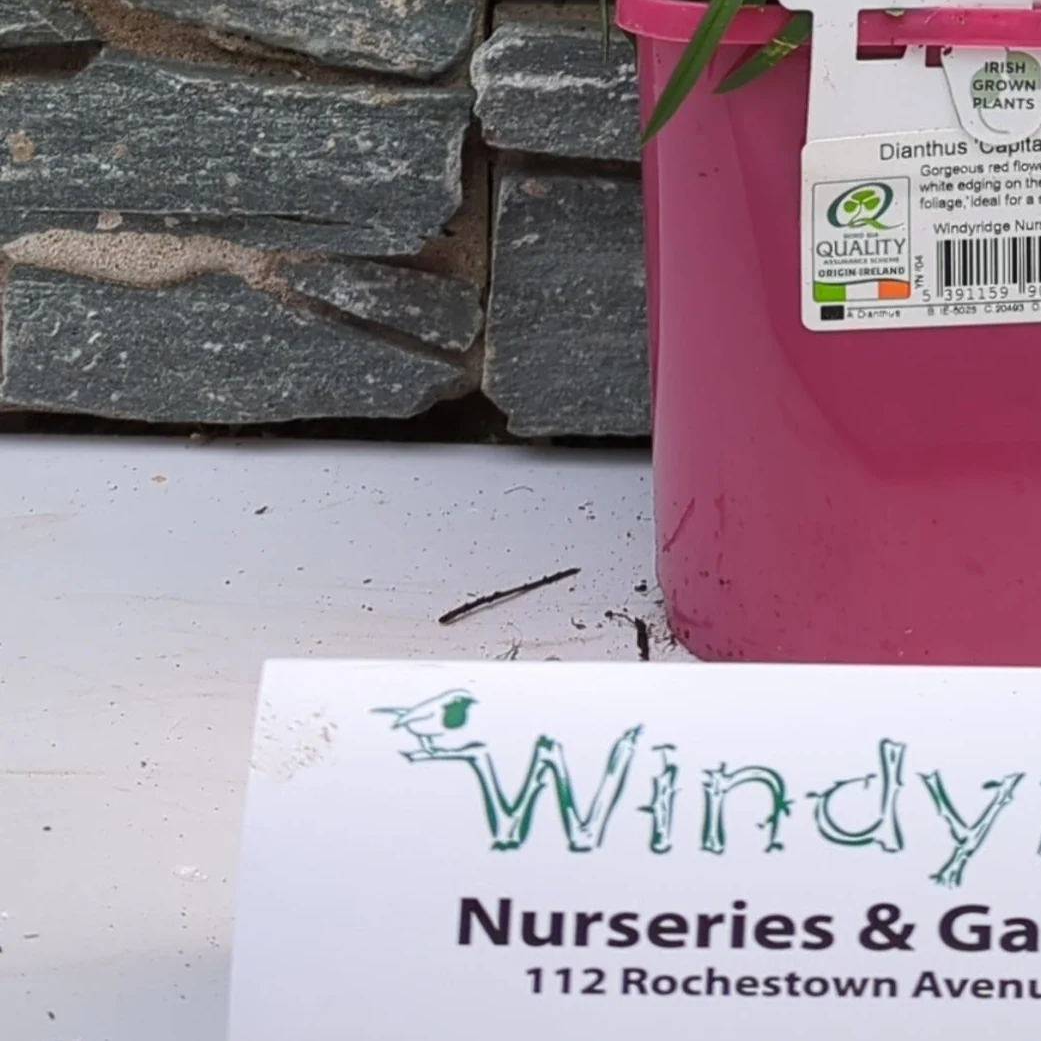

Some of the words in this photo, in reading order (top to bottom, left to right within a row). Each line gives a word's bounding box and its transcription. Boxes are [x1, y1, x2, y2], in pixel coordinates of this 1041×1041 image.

[984, 61, 1026, 74] IRISH
[972, 79, 1036, 91] GROWN
[973, 97, 1035, 110] PLANTS
[880, 140, 968, 160] Dianthus
[920, 163, 984, 178] Gorgeous
[989, 162, 1009, 173] red
[919, 180, 954, 193] white
[957, 178, 1001, 194] edging
[1005, 180, 1021, 189] on
[970, 195, 1001, 207] ideal
[1005, 194, 1022, 206] for
[1026, 196, 1034, 205] a
[933, 220, 1011, 236] Windyridge
[816, 238, 906, 258] QUALITY
[922, 289, 931, 302] 5
[944, 286, 1009, 301] 391159
[457, 896, 835, 950] Nurseries
[858, 902, 917, 952] &
[526, 967, 606, 995] 112
[621, 966, 898, 999] Rochestown
